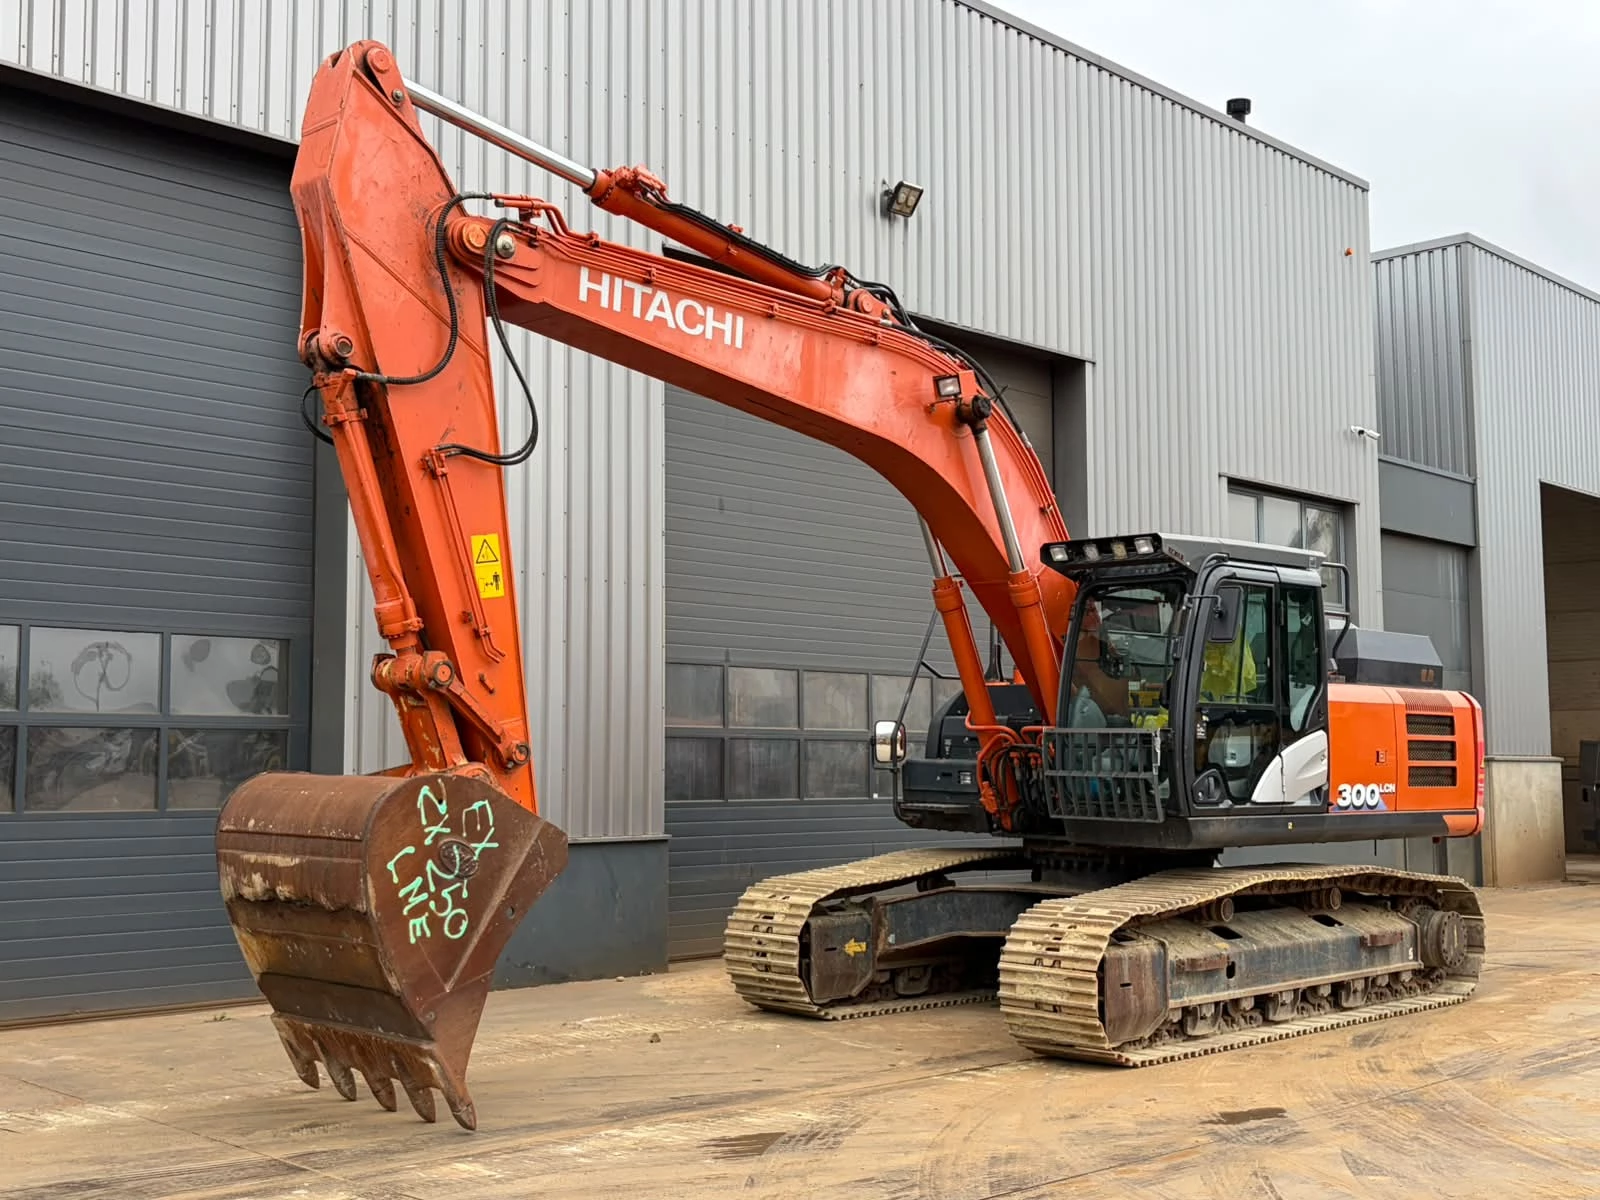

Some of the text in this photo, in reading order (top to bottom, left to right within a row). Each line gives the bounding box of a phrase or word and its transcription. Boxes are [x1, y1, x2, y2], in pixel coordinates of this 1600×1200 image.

[578, 266, 744, 349] HITACHI
[462, 800, 499, 860] EX
[426, 845, 468, 939] 250
